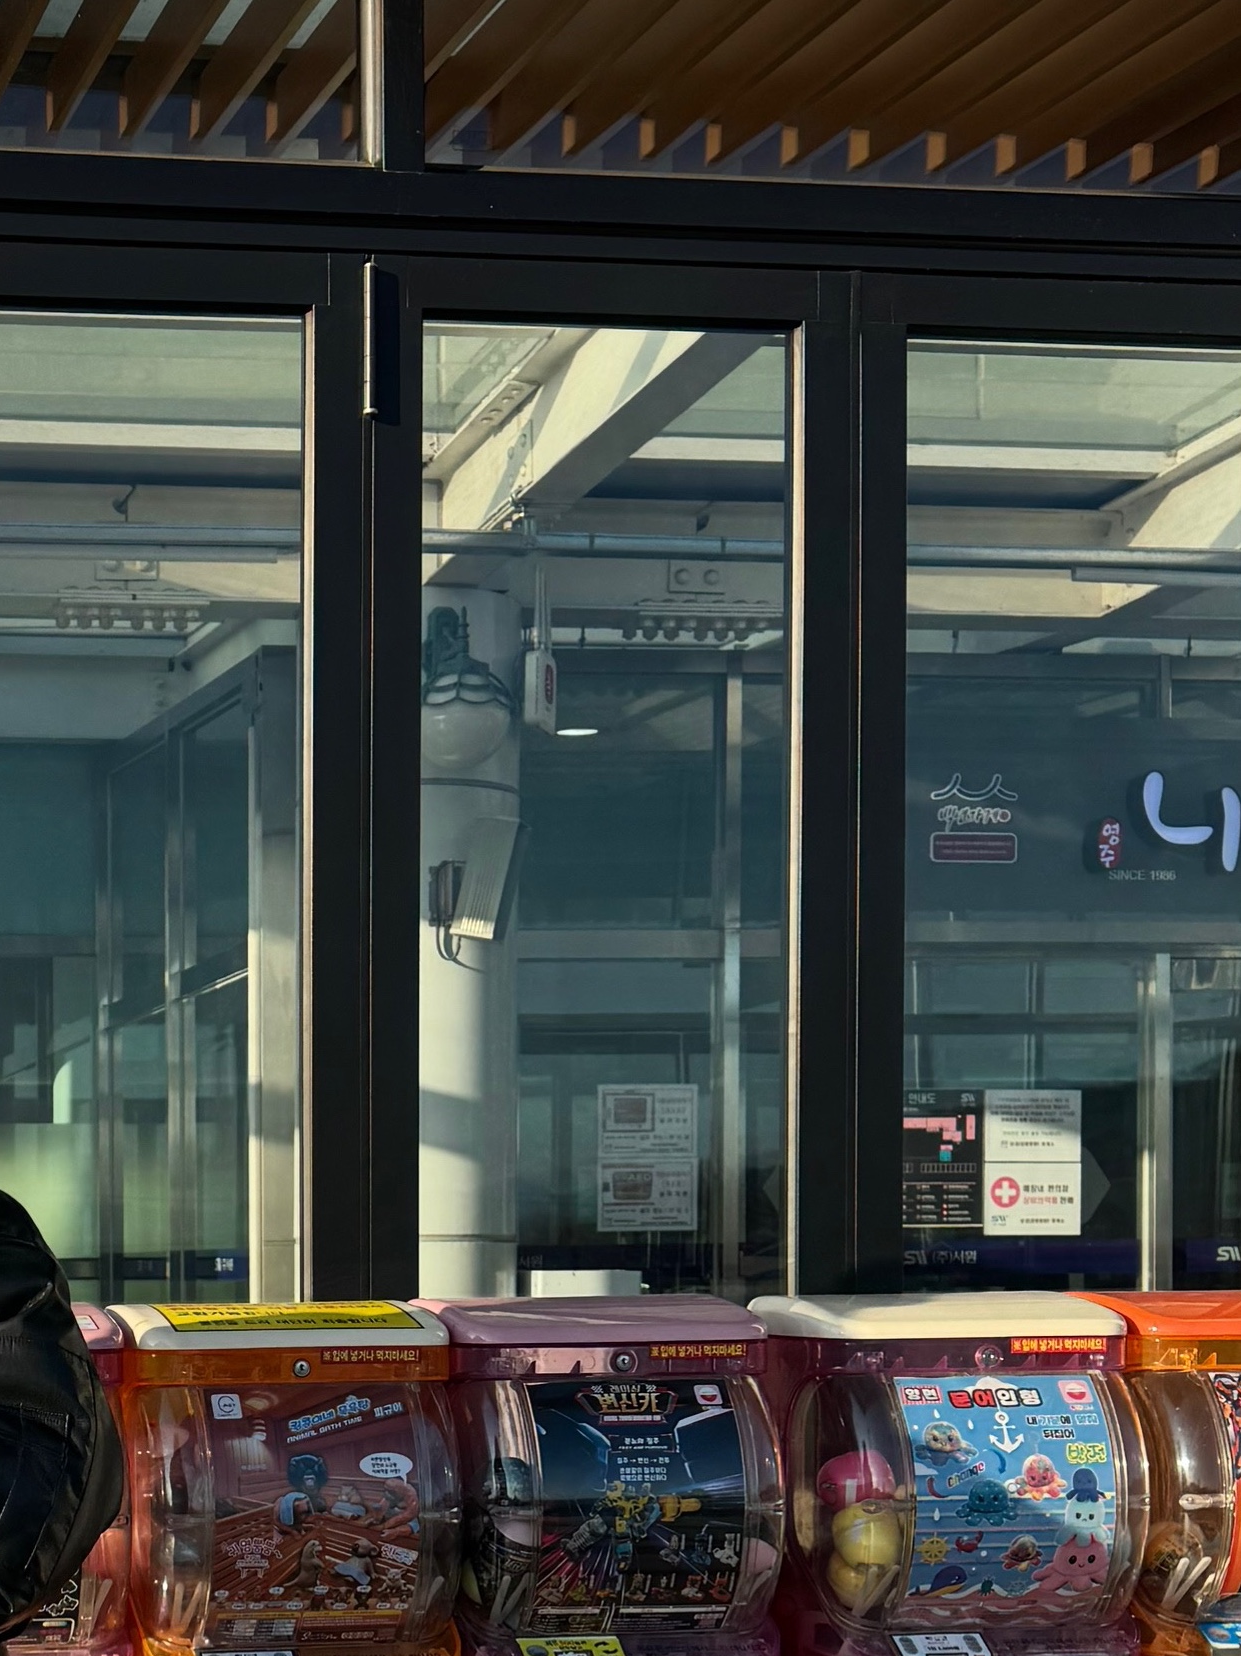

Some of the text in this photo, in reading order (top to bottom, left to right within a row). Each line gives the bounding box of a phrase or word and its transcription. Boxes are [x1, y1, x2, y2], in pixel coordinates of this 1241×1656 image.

[1108, 869, 1146, 881] SINCE
[932, 1250, 977, 1265] (주)서원
[678, 1345, 702, 1357] 넣거나
[703, 1344, 746, 1357] 먹지마세요!
[1039, 1339, 1063, 1352] 넣거나
[1064, 1338, 1107, 1351] 먹지마세요!
[350, 1350, 374, 1362] 넣거나
[375, 1350, 419, 1361] 먹지마세요!
[597, 1392, 662, 1413] 변신카
[904, 1388, 1043, 1409] 양면 문어인형
[373, 1402, 404, 1419] 피규어
[1025, 1415, 1037, 1426] 내
[286, 1430, 319, 1444] ANIMAL
[342, 1415, 363, 1428] TIME
[947, 1460, 985, 1488] change
